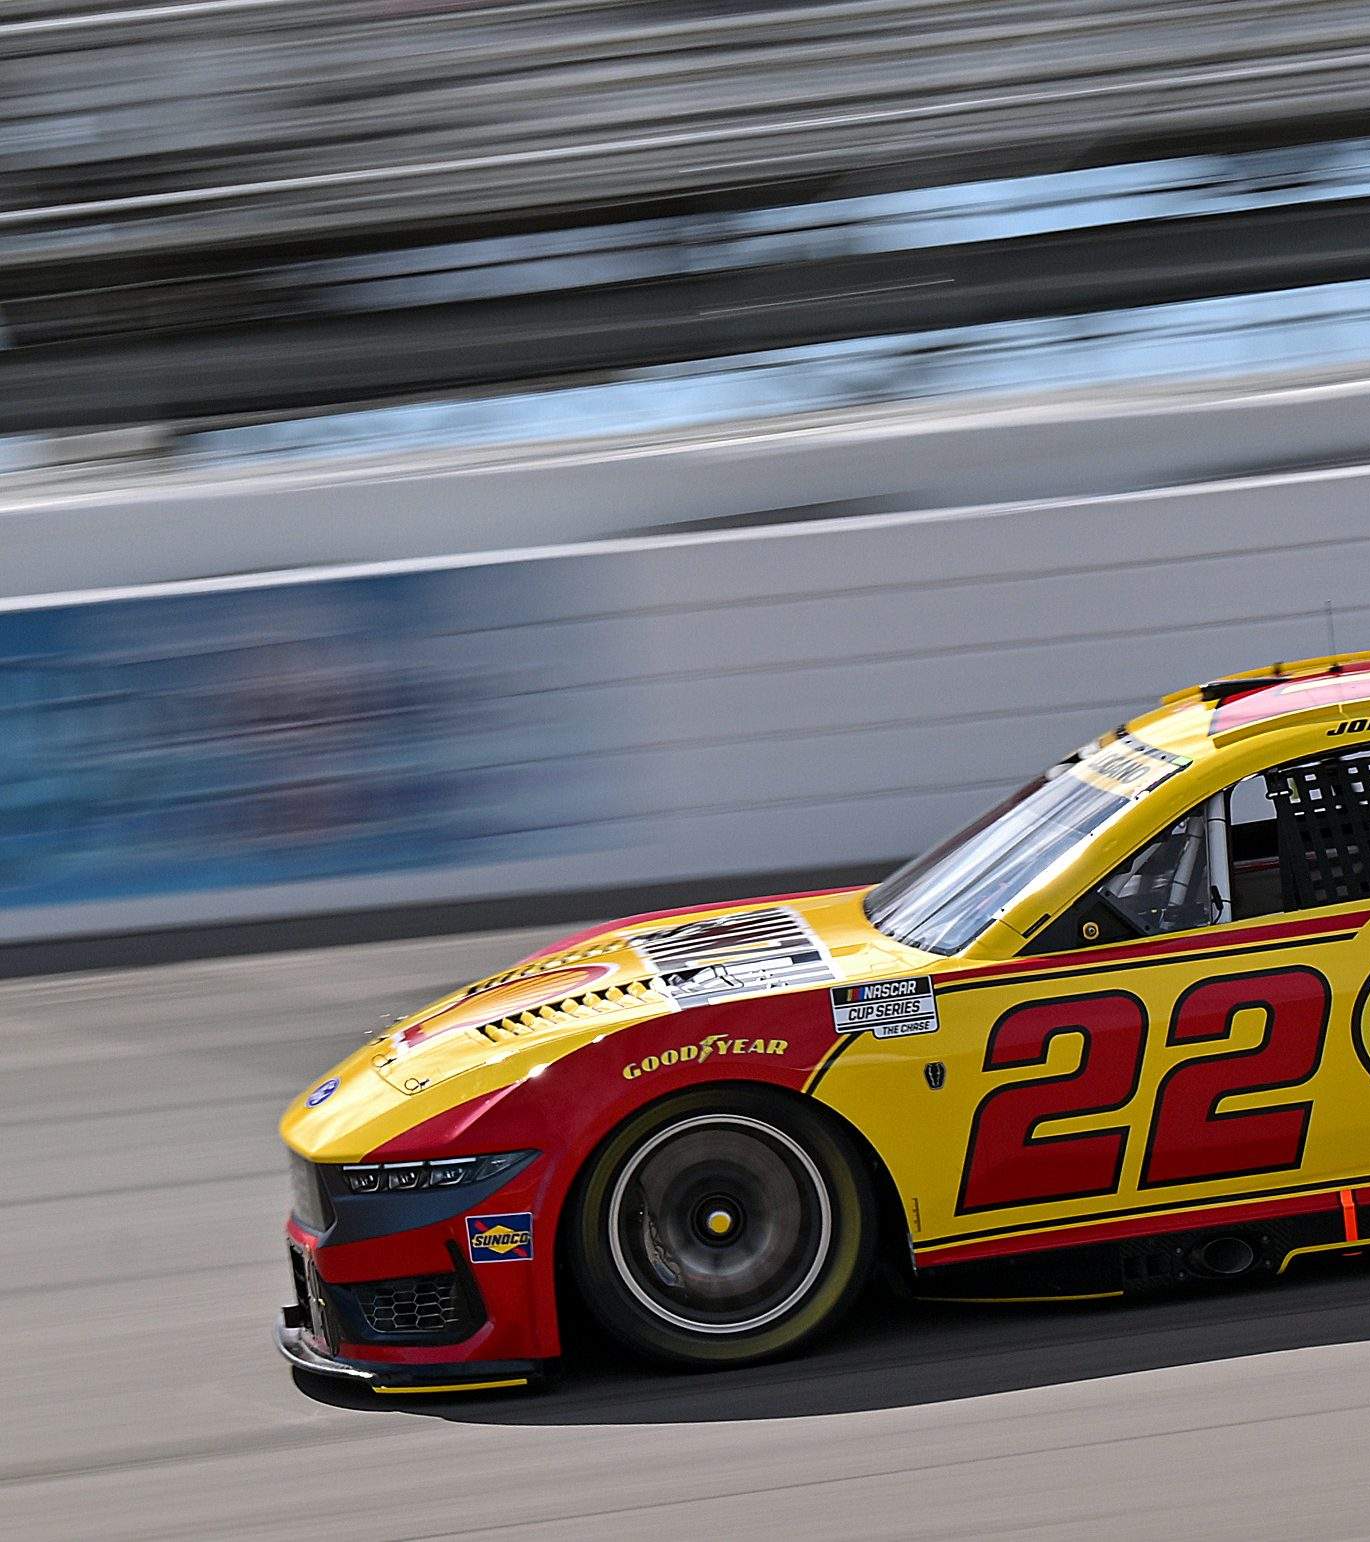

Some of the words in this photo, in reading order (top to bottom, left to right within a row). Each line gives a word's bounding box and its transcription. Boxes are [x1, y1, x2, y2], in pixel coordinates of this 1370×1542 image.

[864, 981, 917, 1000] NASCAR
[848, 1006, 874, 1021] CUP
[876, 1000, 921, 1017] SERIES
[882, 1025, 899, 1035] THE
[900, 1021, 931, 1033] CHASE
[622, 1035, 788, 1080] GOODYEAR
[955, 963, 1332, 1216] 22
[473, 1232, 529, 1247] SUNOCO
